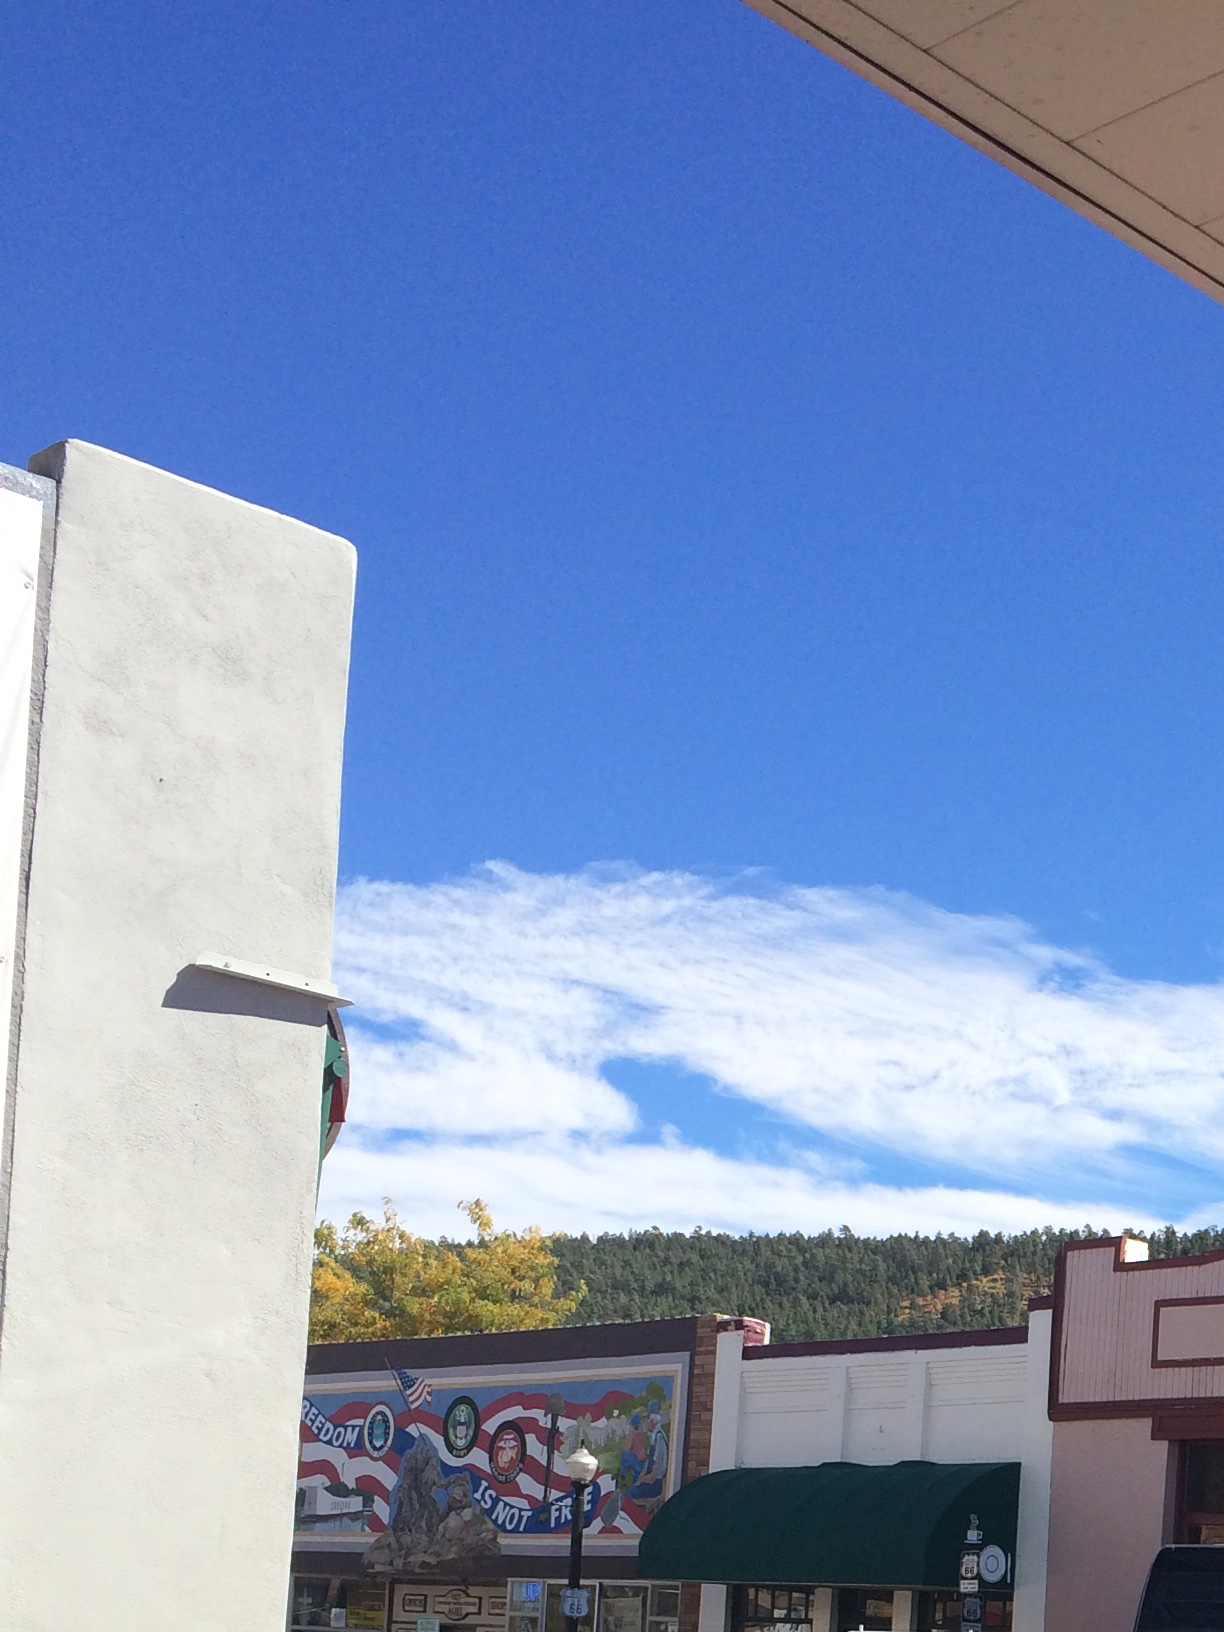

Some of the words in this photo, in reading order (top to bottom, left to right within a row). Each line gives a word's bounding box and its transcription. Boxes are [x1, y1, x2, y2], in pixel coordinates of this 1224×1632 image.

[302, 1399, 360, 1448] REEDOM
[474, 1479, 497, 1510] IS
[490, 1501, 533, 1532] NOT
[549, 1485, 594, 1529] FRE
[964, 1566, 975, 1575] 66
[569, 1603, 582, 1614] 66
